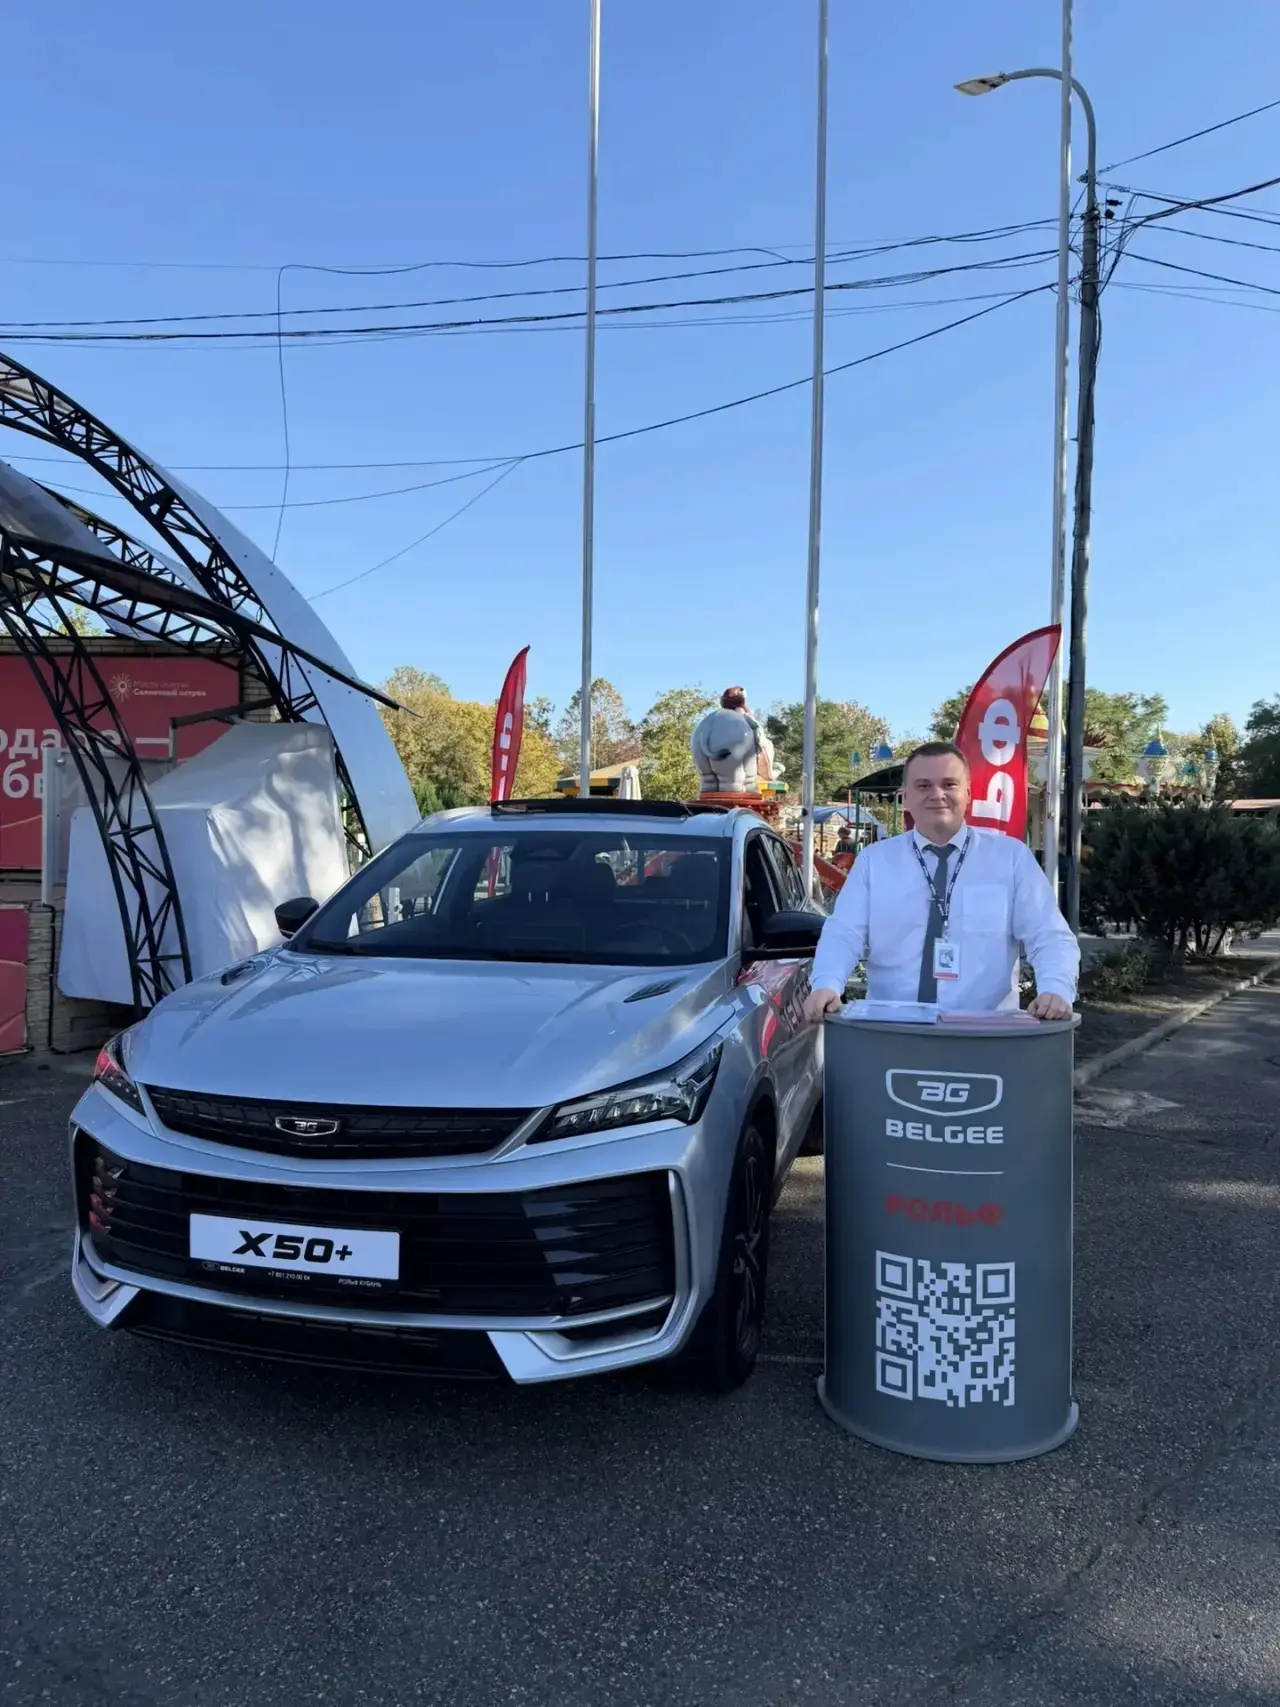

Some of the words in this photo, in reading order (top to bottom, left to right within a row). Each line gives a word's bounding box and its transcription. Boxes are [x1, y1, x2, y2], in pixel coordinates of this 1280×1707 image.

[971, 698, 1021, 834] ЬФ
[917, 1080, 970, 1103] BG
[886, 1118, 1003, 1144] BELGEE
[886, 1194, 1003, 1227] РОЛЬФ
[232, 1230, 353, 1263] X50+
[219, 1265, 246, 1274] BELGEE
